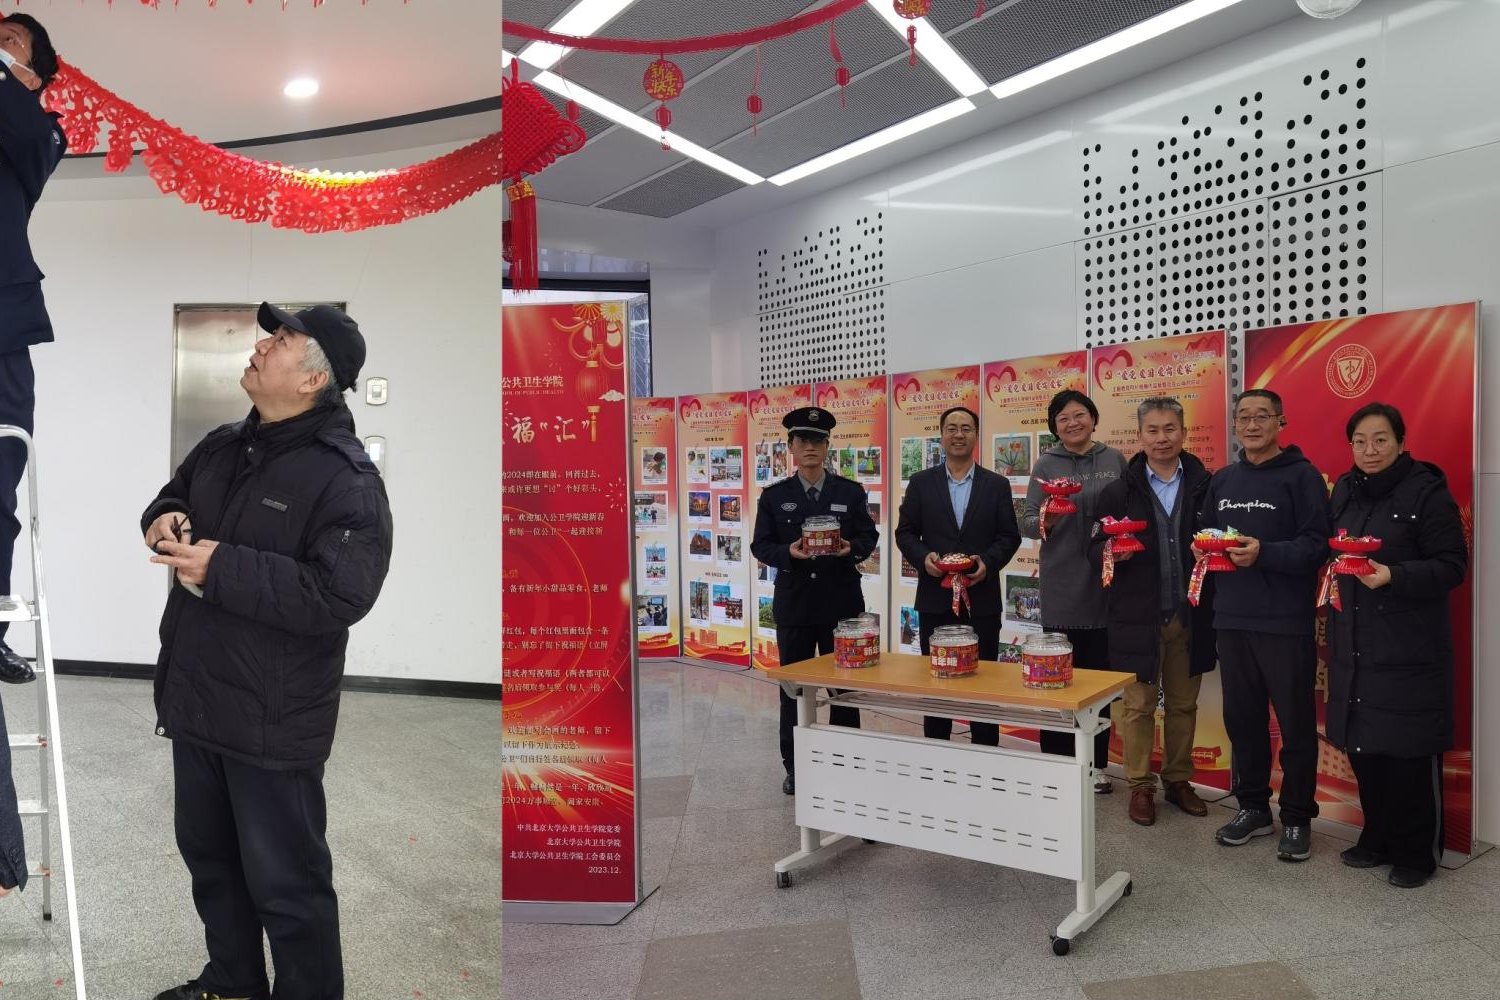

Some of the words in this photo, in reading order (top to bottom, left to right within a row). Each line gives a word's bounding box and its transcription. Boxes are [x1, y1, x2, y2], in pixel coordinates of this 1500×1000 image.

[502, 375, 564, 388] 公共卫生学院
[1218, 499, 1276, 513] Champion
[547, 837, 621, 848] 北京大学公共卫生学院
